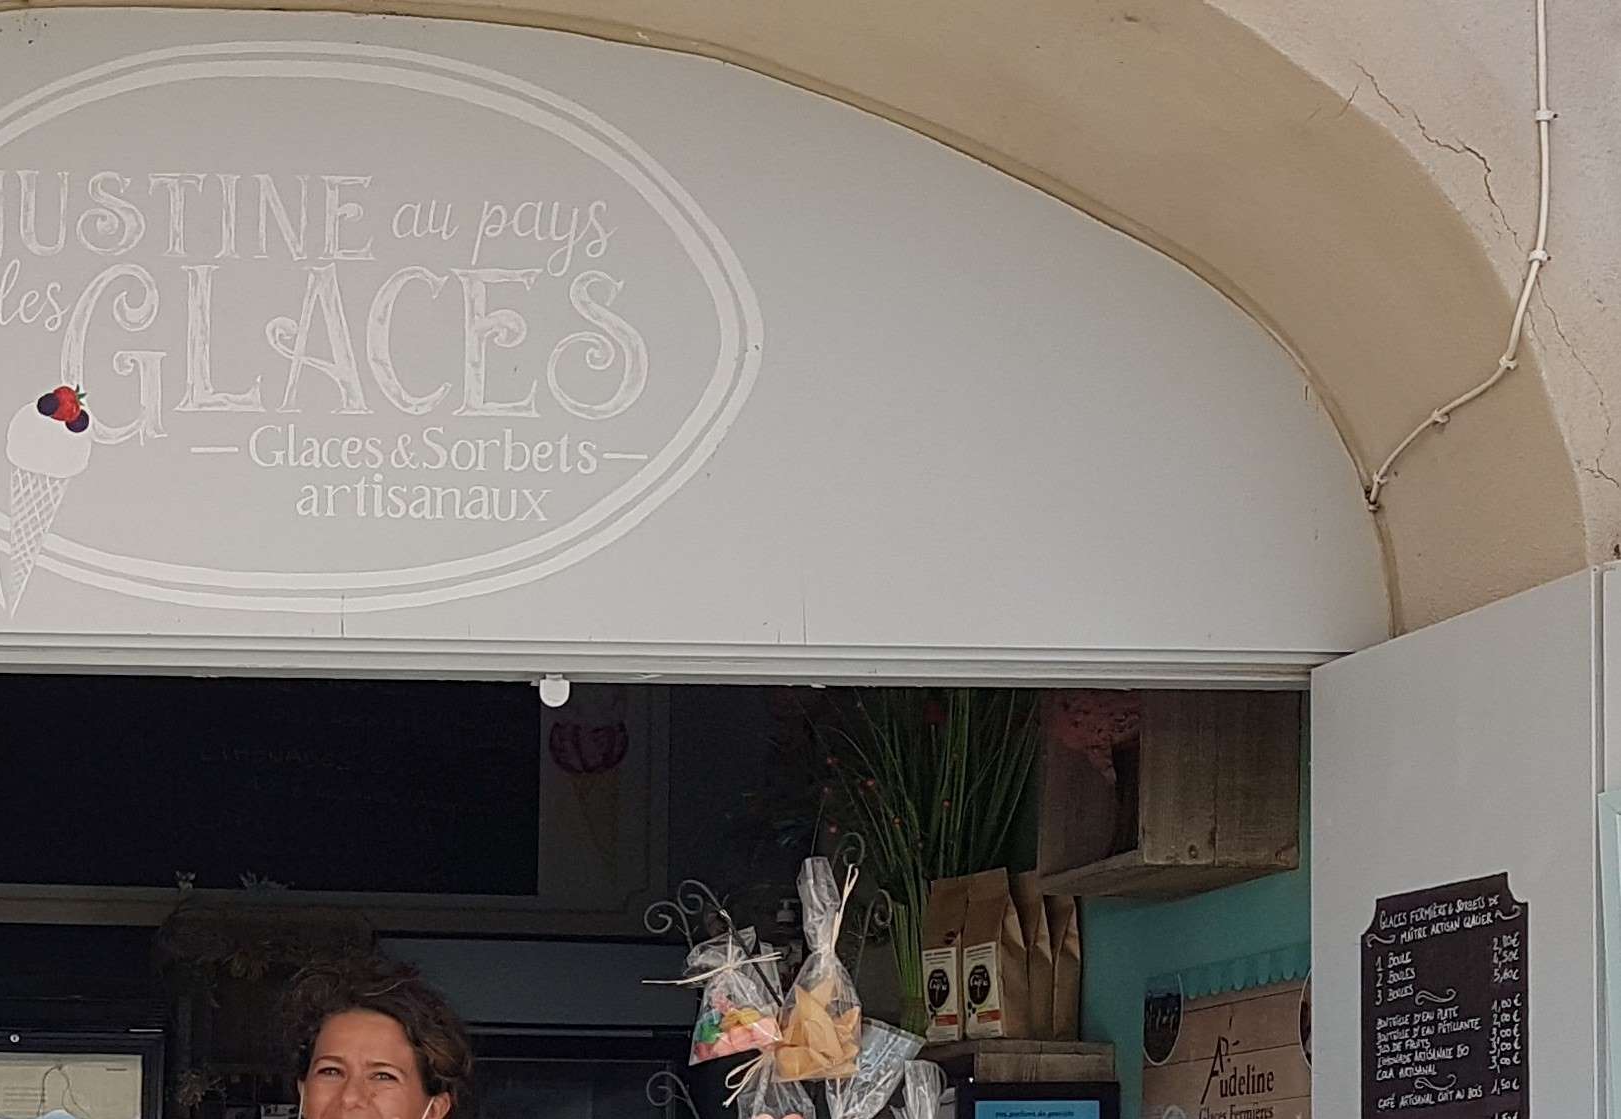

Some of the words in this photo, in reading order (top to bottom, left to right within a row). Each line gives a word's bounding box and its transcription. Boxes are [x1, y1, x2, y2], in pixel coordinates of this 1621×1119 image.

[391, 198, 457, 240] au
[473, 200, 615, 278] pays
[59, 264, 649, 447] GLACES
[249, 424, 382, 468] Glaces
[390, 434, 419, 470] &
[423, 426, 598, 475] Sorbets
[296, 473, 552, 522] artisanaux
[1380, 910, 1407, 930] GLACES
[1200, 1035, 1275, 1104] Audeline
